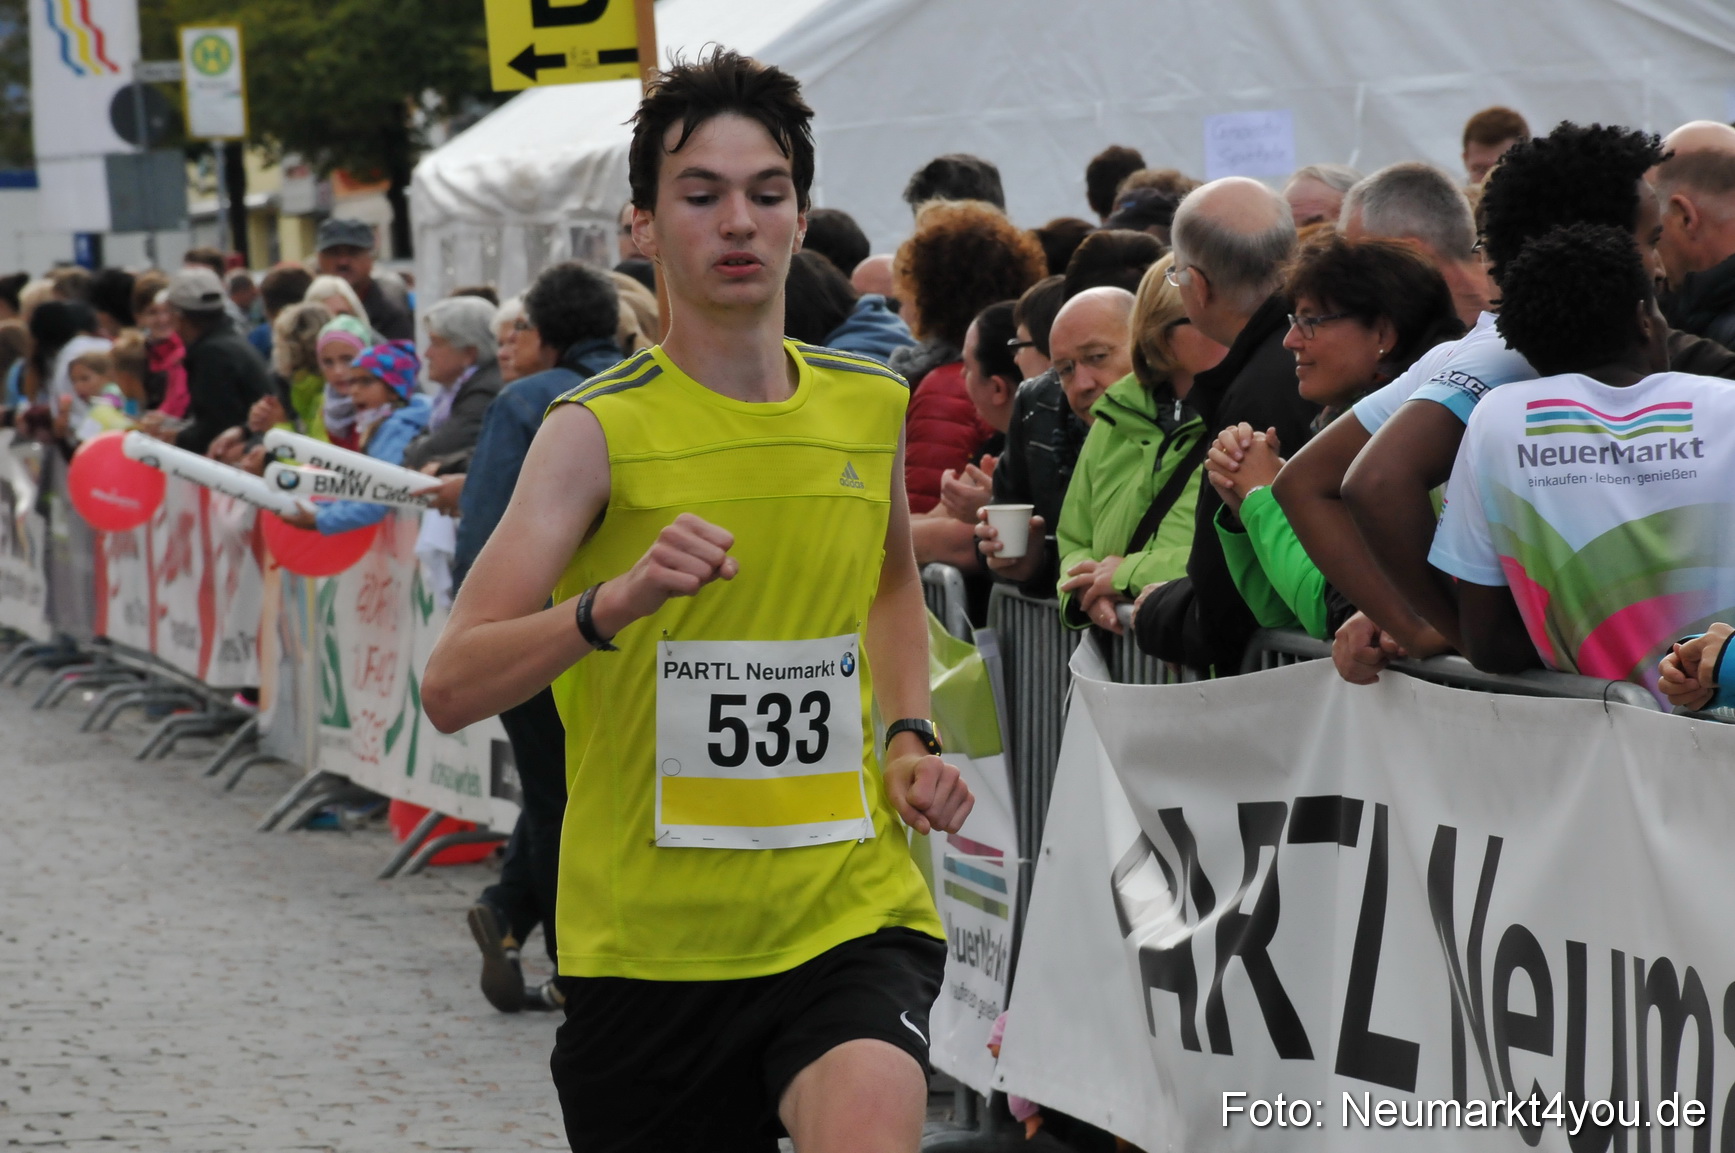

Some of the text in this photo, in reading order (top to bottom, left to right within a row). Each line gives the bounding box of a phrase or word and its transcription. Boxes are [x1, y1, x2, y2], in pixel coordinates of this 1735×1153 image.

[1517, 437, 1705, 468] NeuerMarkt
[1528, 469, 1697, 487] einkaufen leben genießen
[663, 660, 835, 681] PARTL Neumarkt
[707, 690, 831, 768] 533
